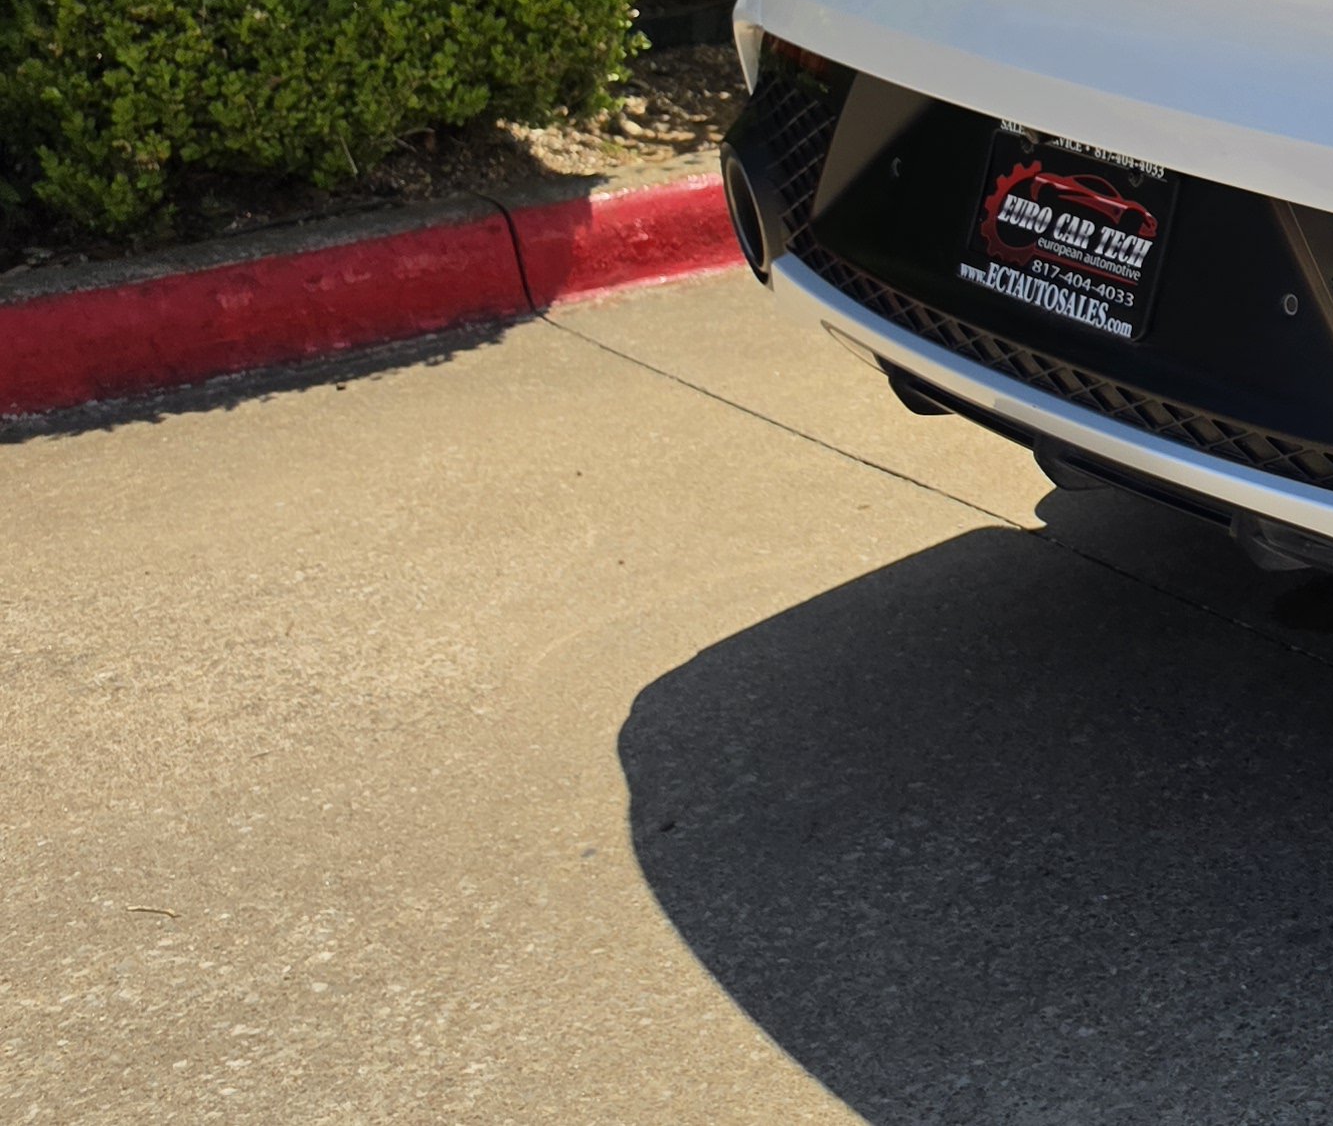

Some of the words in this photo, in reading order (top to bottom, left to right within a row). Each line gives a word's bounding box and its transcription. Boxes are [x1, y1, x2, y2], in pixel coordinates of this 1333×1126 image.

[997, 193, 1053, 235] EURO
[1053, 212, 1096, 250] CAR
[1095, 225, 1153, 269] TECH
[1037, 235, 1084, 261] european
[1083, 249, 1142, 282] automotive
[959, 262, 1133, 339] www.ECTAUTOSALES.com
[1032, 258, 1135, 307] 817-404-4033
